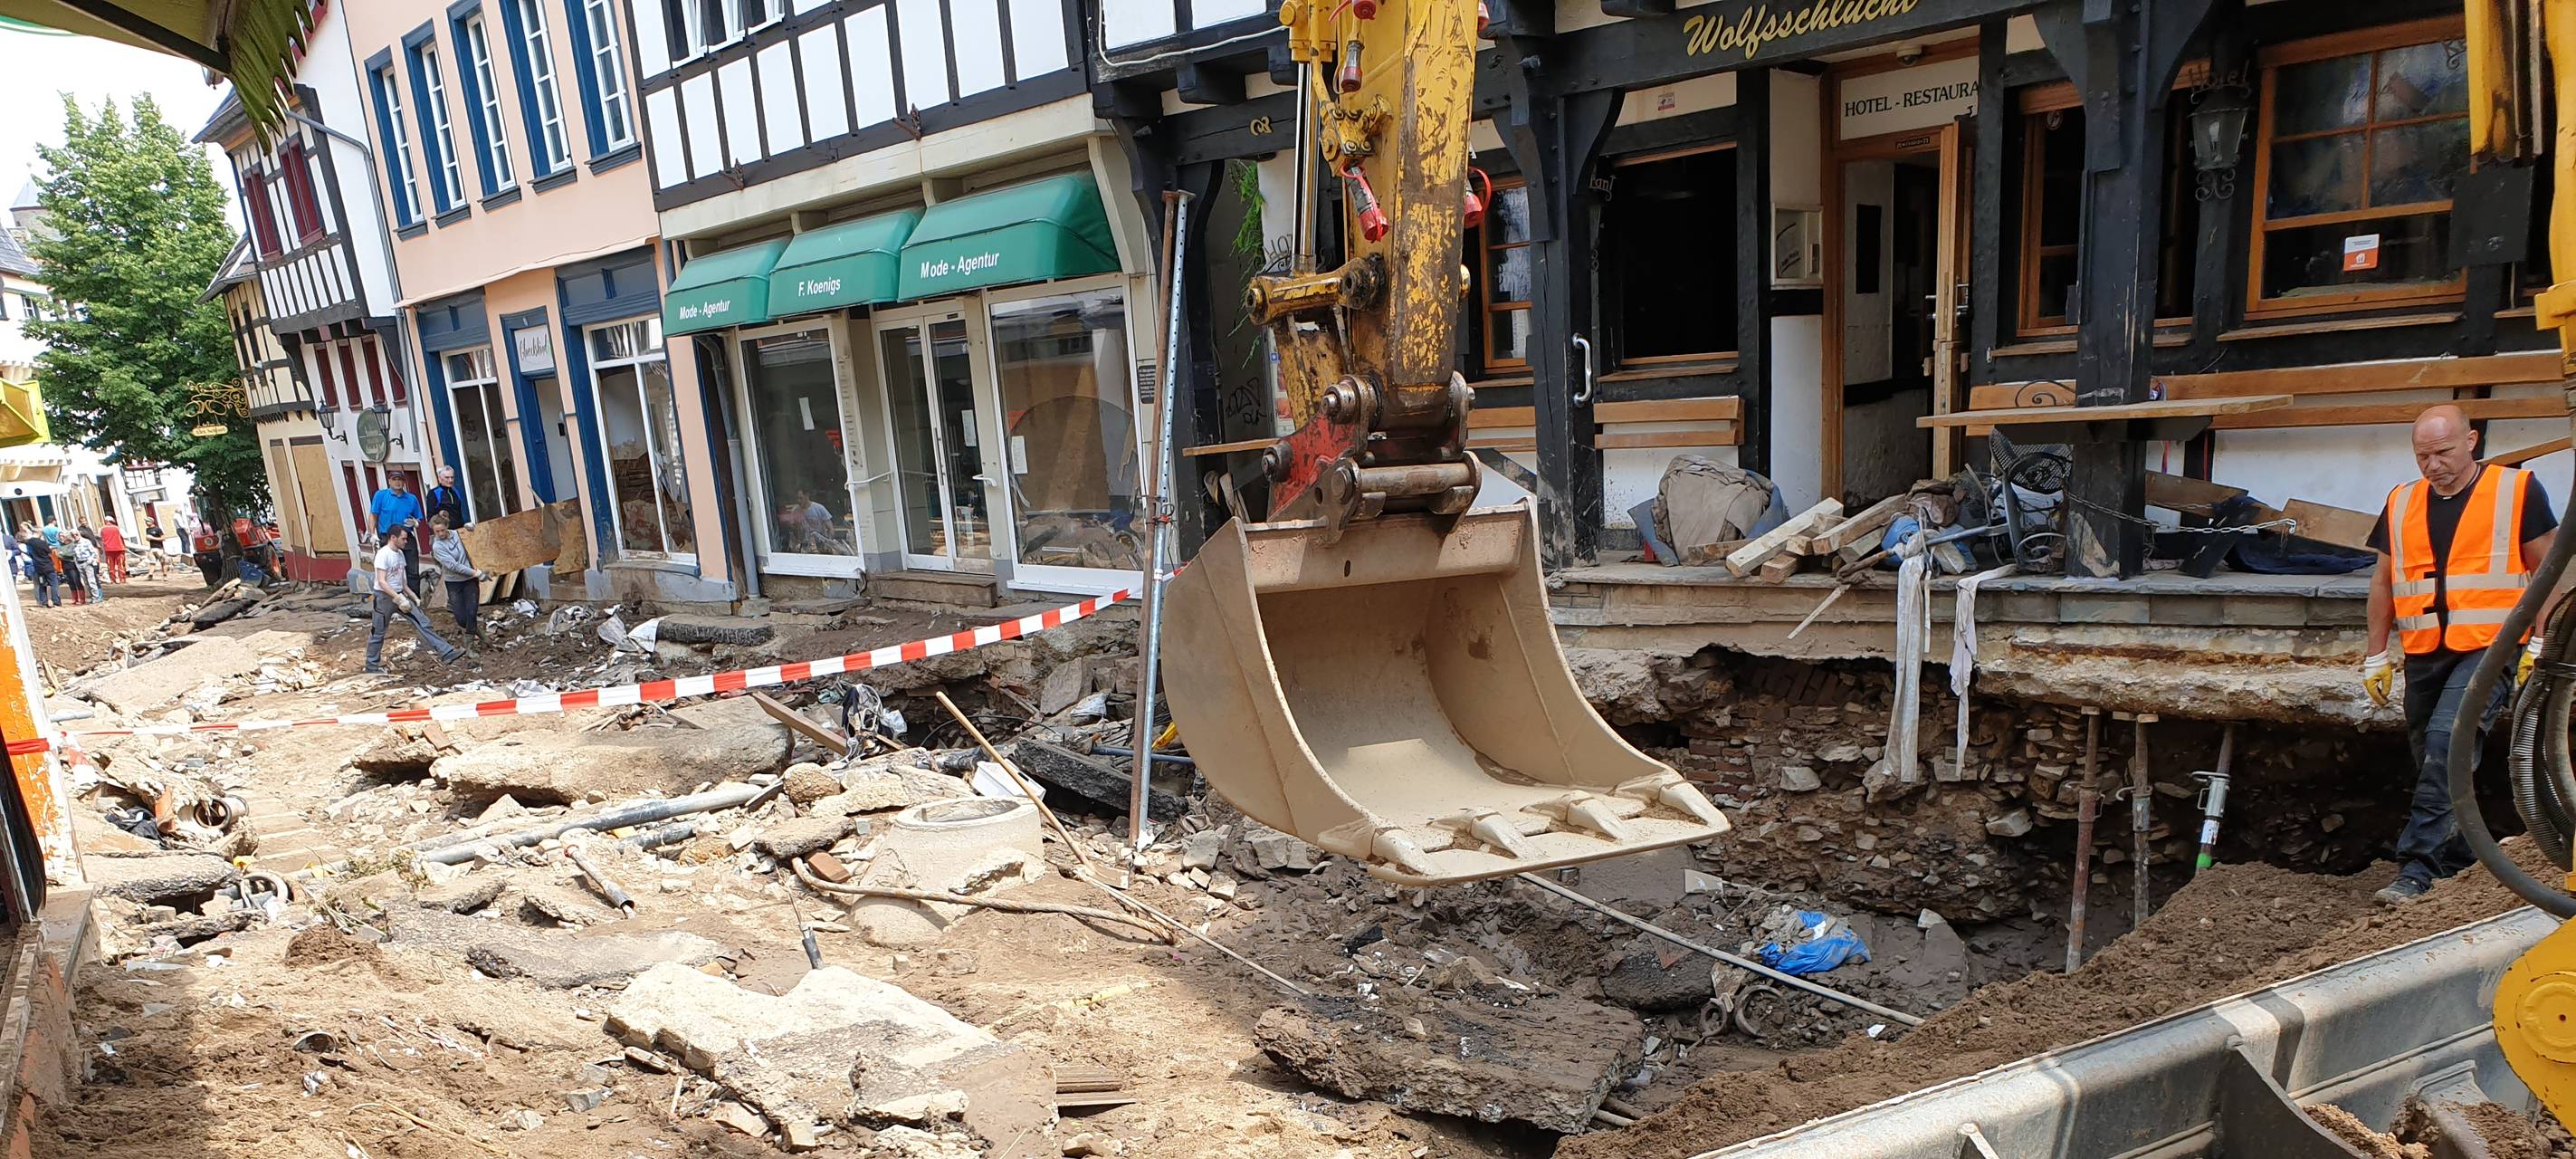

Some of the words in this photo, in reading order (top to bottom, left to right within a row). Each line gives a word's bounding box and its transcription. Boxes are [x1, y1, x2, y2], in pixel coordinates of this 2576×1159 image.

[1845, 96, 1892, 117] HOTEL
[921, 260, 949, 279] Mode
[957, 252, 999, 275] Agentur
[798, 281, 805, 297] F.
[807, 276, 841, 296] Koenigs
[680, 303, 697, 320] Mode
[702, 299, 730, 319] Agentur
